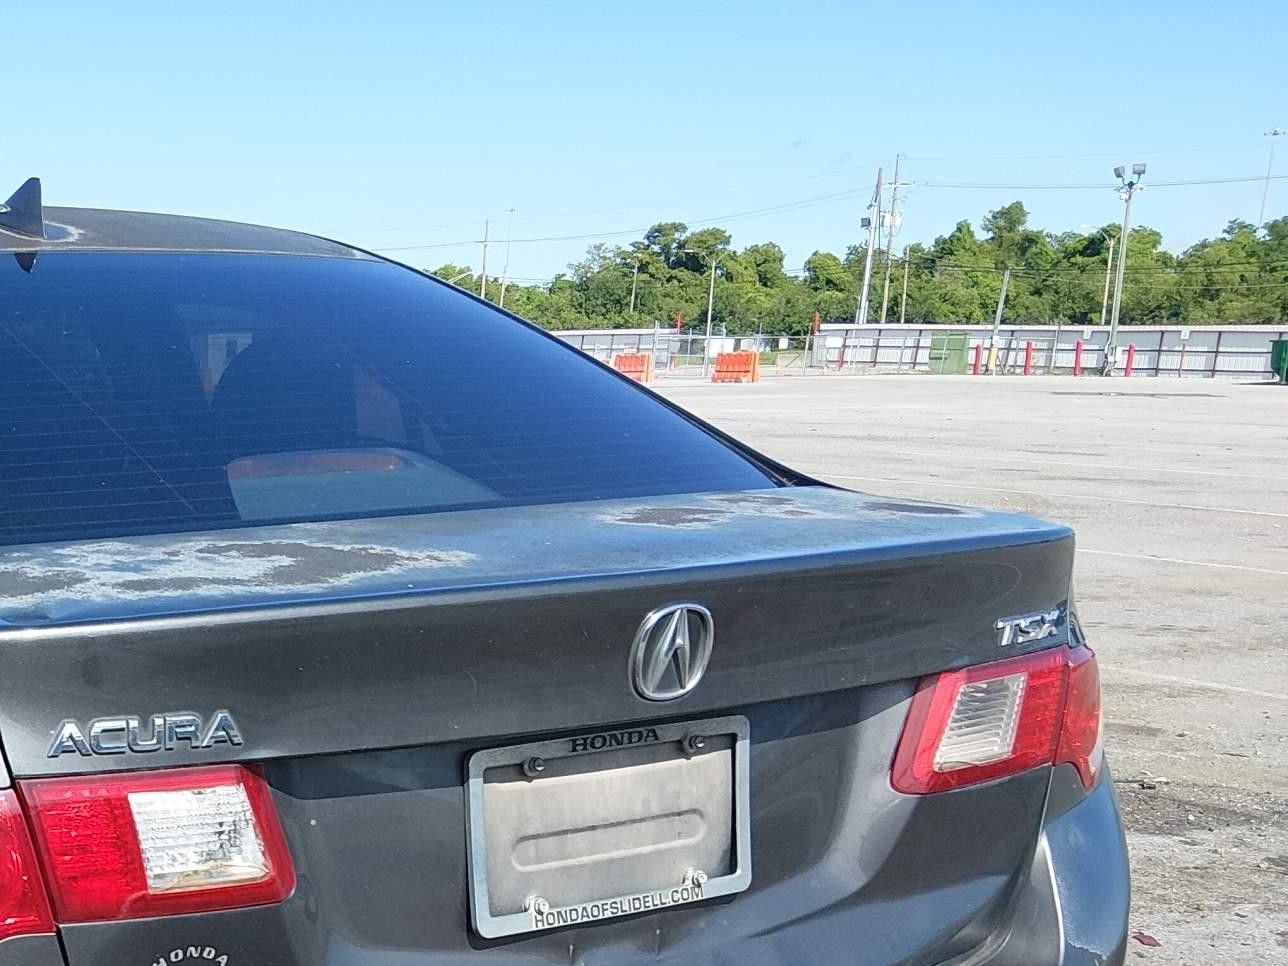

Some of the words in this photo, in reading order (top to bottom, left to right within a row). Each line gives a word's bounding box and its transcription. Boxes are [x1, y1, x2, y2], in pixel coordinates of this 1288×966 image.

[995, 607, 1060, 646] TSX
[47, 709, 243, 758] ACURA
[569, 728, 658, 752] HONDA
[534, 886, 704, 928] HONDAOFSLIDELL.COM
